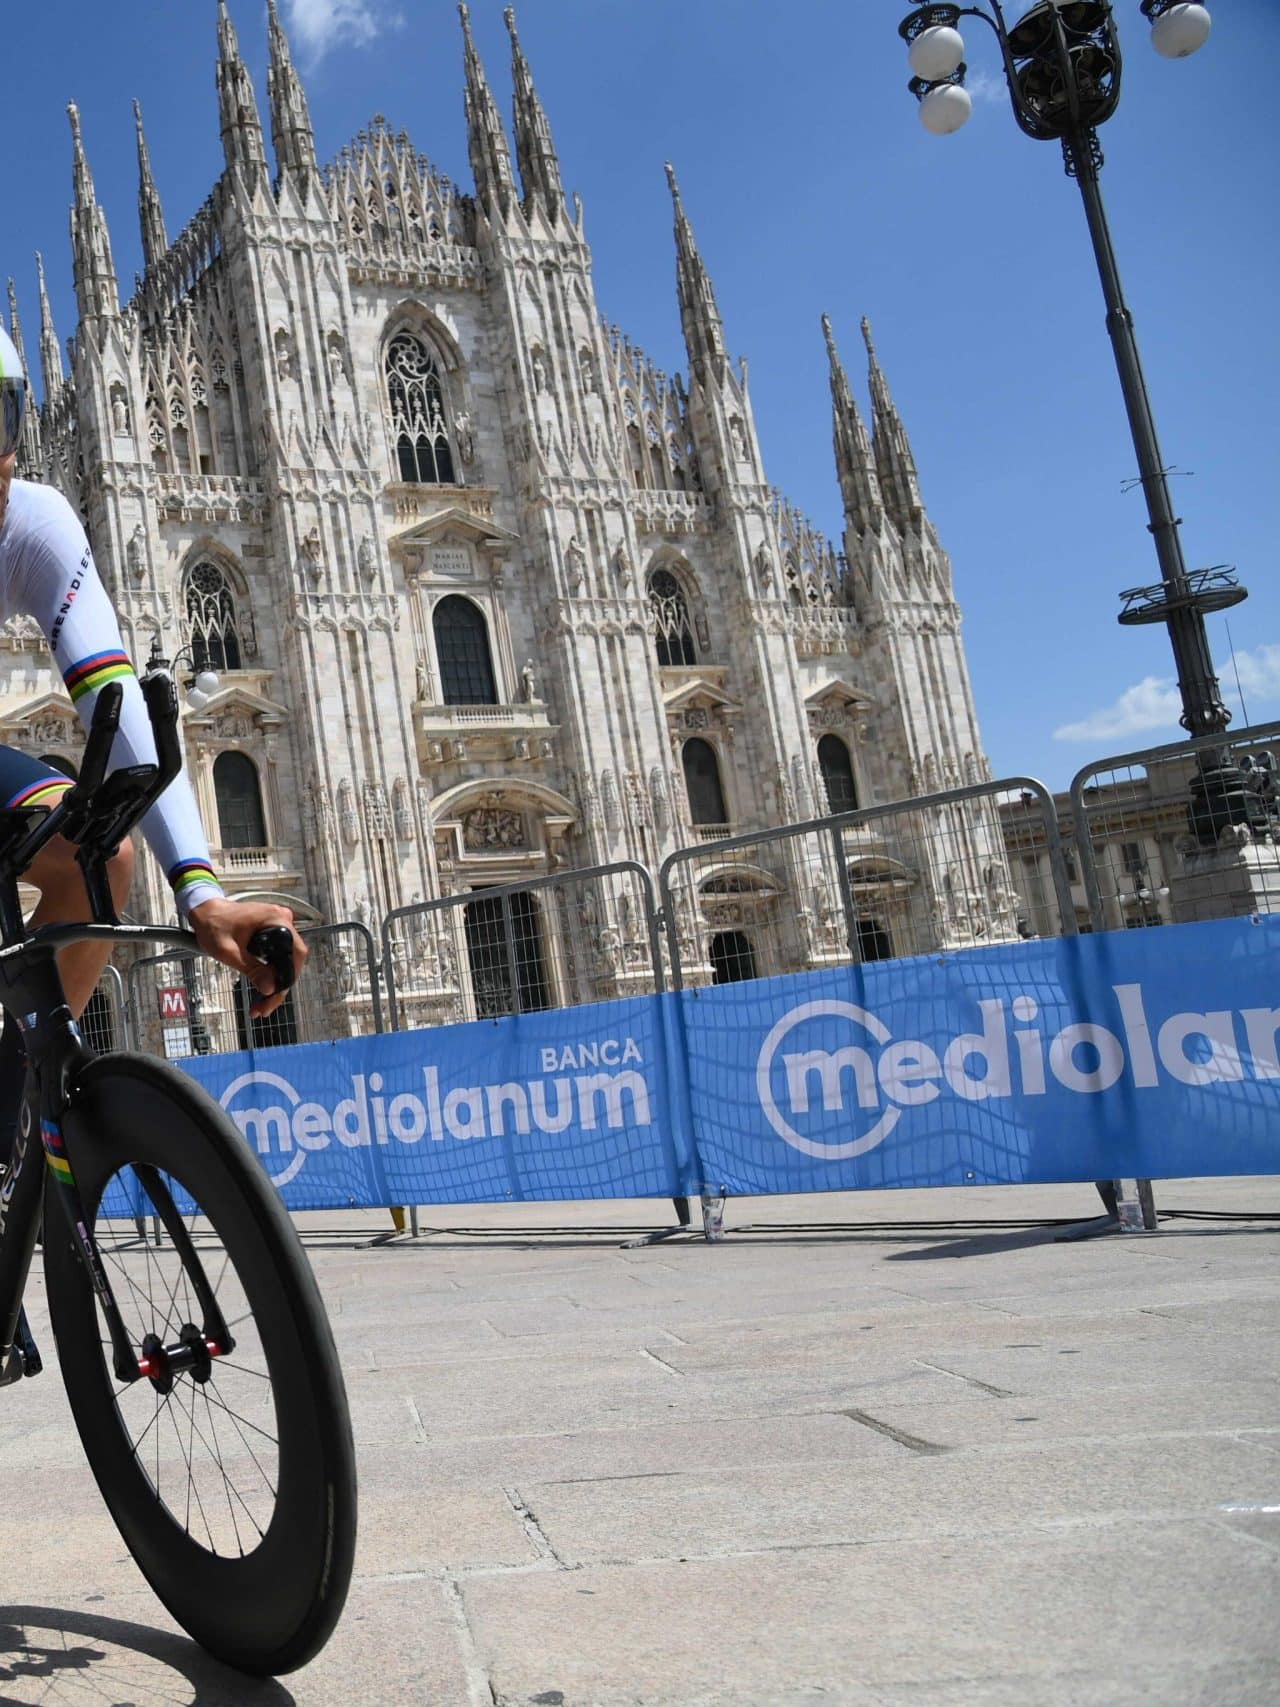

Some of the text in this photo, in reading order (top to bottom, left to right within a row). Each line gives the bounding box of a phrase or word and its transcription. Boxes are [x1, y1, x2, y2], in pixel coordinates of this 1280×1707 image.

[51, 547, 91, 652] GRENADIER
[162, 992, 186, 1013] M
[540, 1038, 643, 1073] BANCA
[231, 1066, 652, 1153] mediolanum
